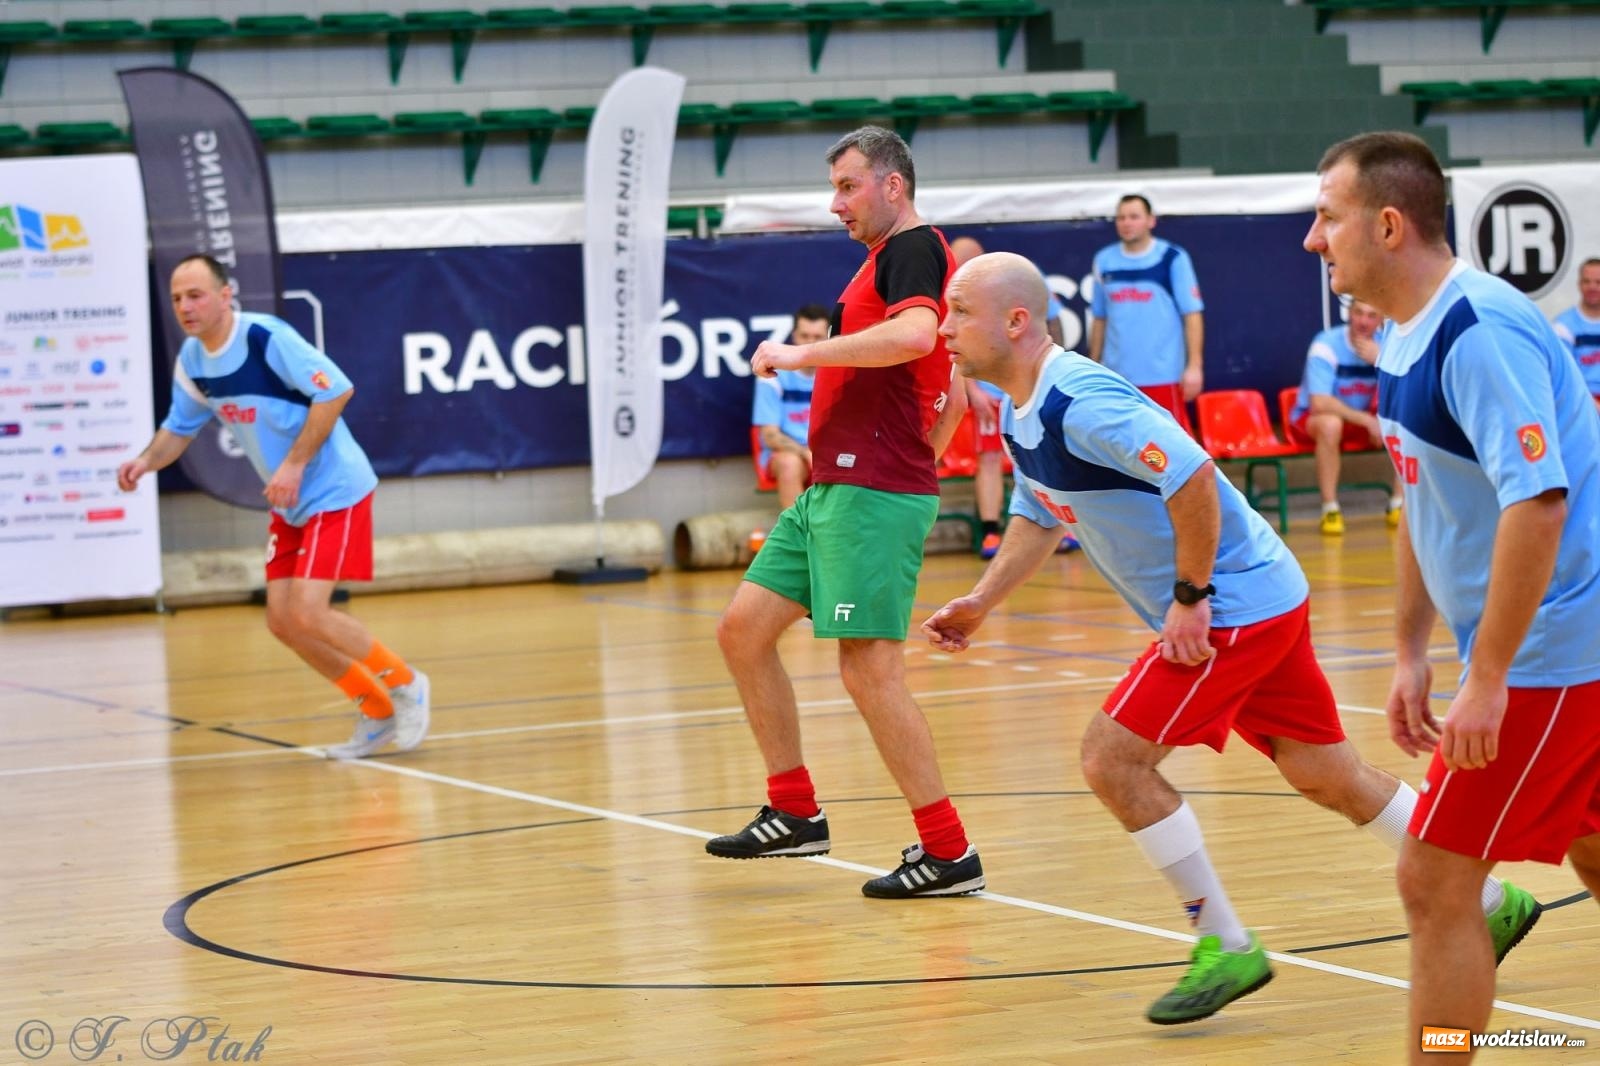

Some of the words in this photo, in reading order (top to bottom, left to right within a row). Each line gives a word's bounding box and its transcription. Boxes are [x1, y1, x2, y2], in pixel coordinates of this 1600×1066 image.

[615, 127, 636, 256] TRENING
[1488, 204, 1557, 275] JR
[5, 309, 59, 323] JUNIOR
[63, 306, 126, 319] TRENING
[614, 266, 628, 375] JUNIOR
